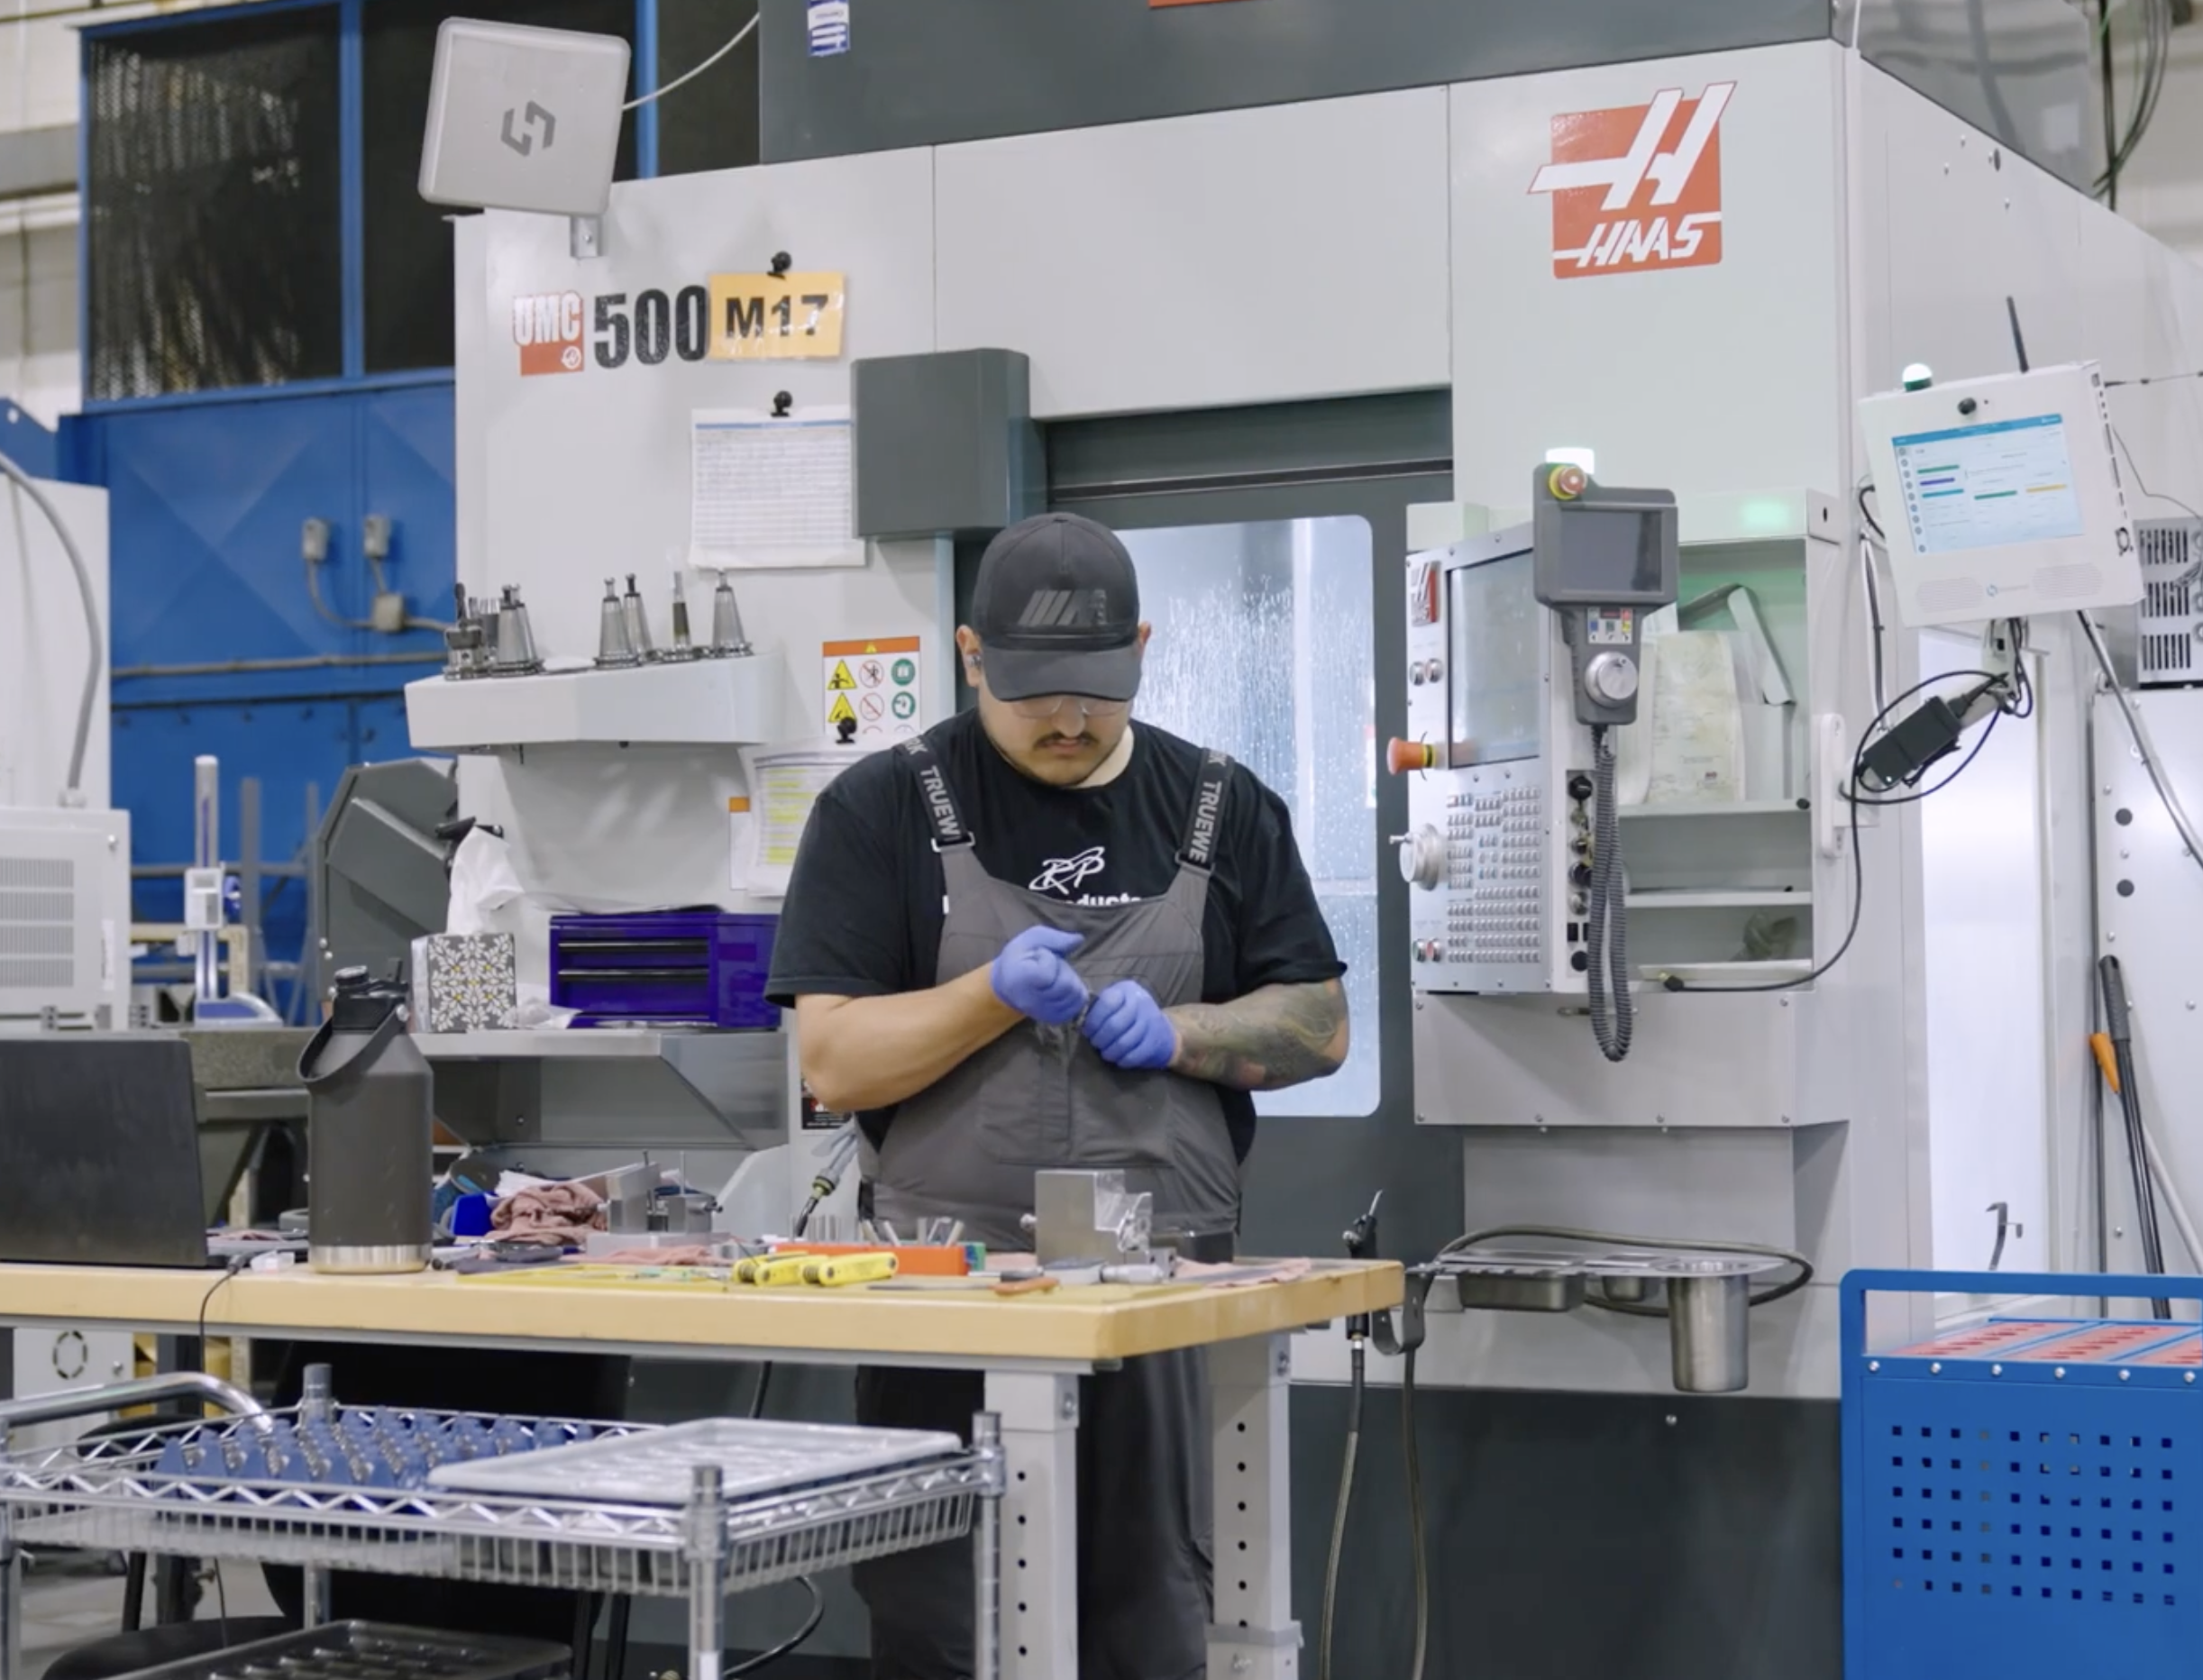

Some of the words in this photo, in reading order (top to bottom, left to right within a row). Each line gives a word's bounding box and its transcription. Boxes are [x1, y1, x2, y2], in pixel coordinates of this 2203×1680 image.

[1553, 212, 1722, 268] HAAS
[512, 290, 582, 346] UMC
[593, 285, 708, 369] 500
[726, 294, 828, 339] M17
[920, 765, 962, 842] TRUEW
